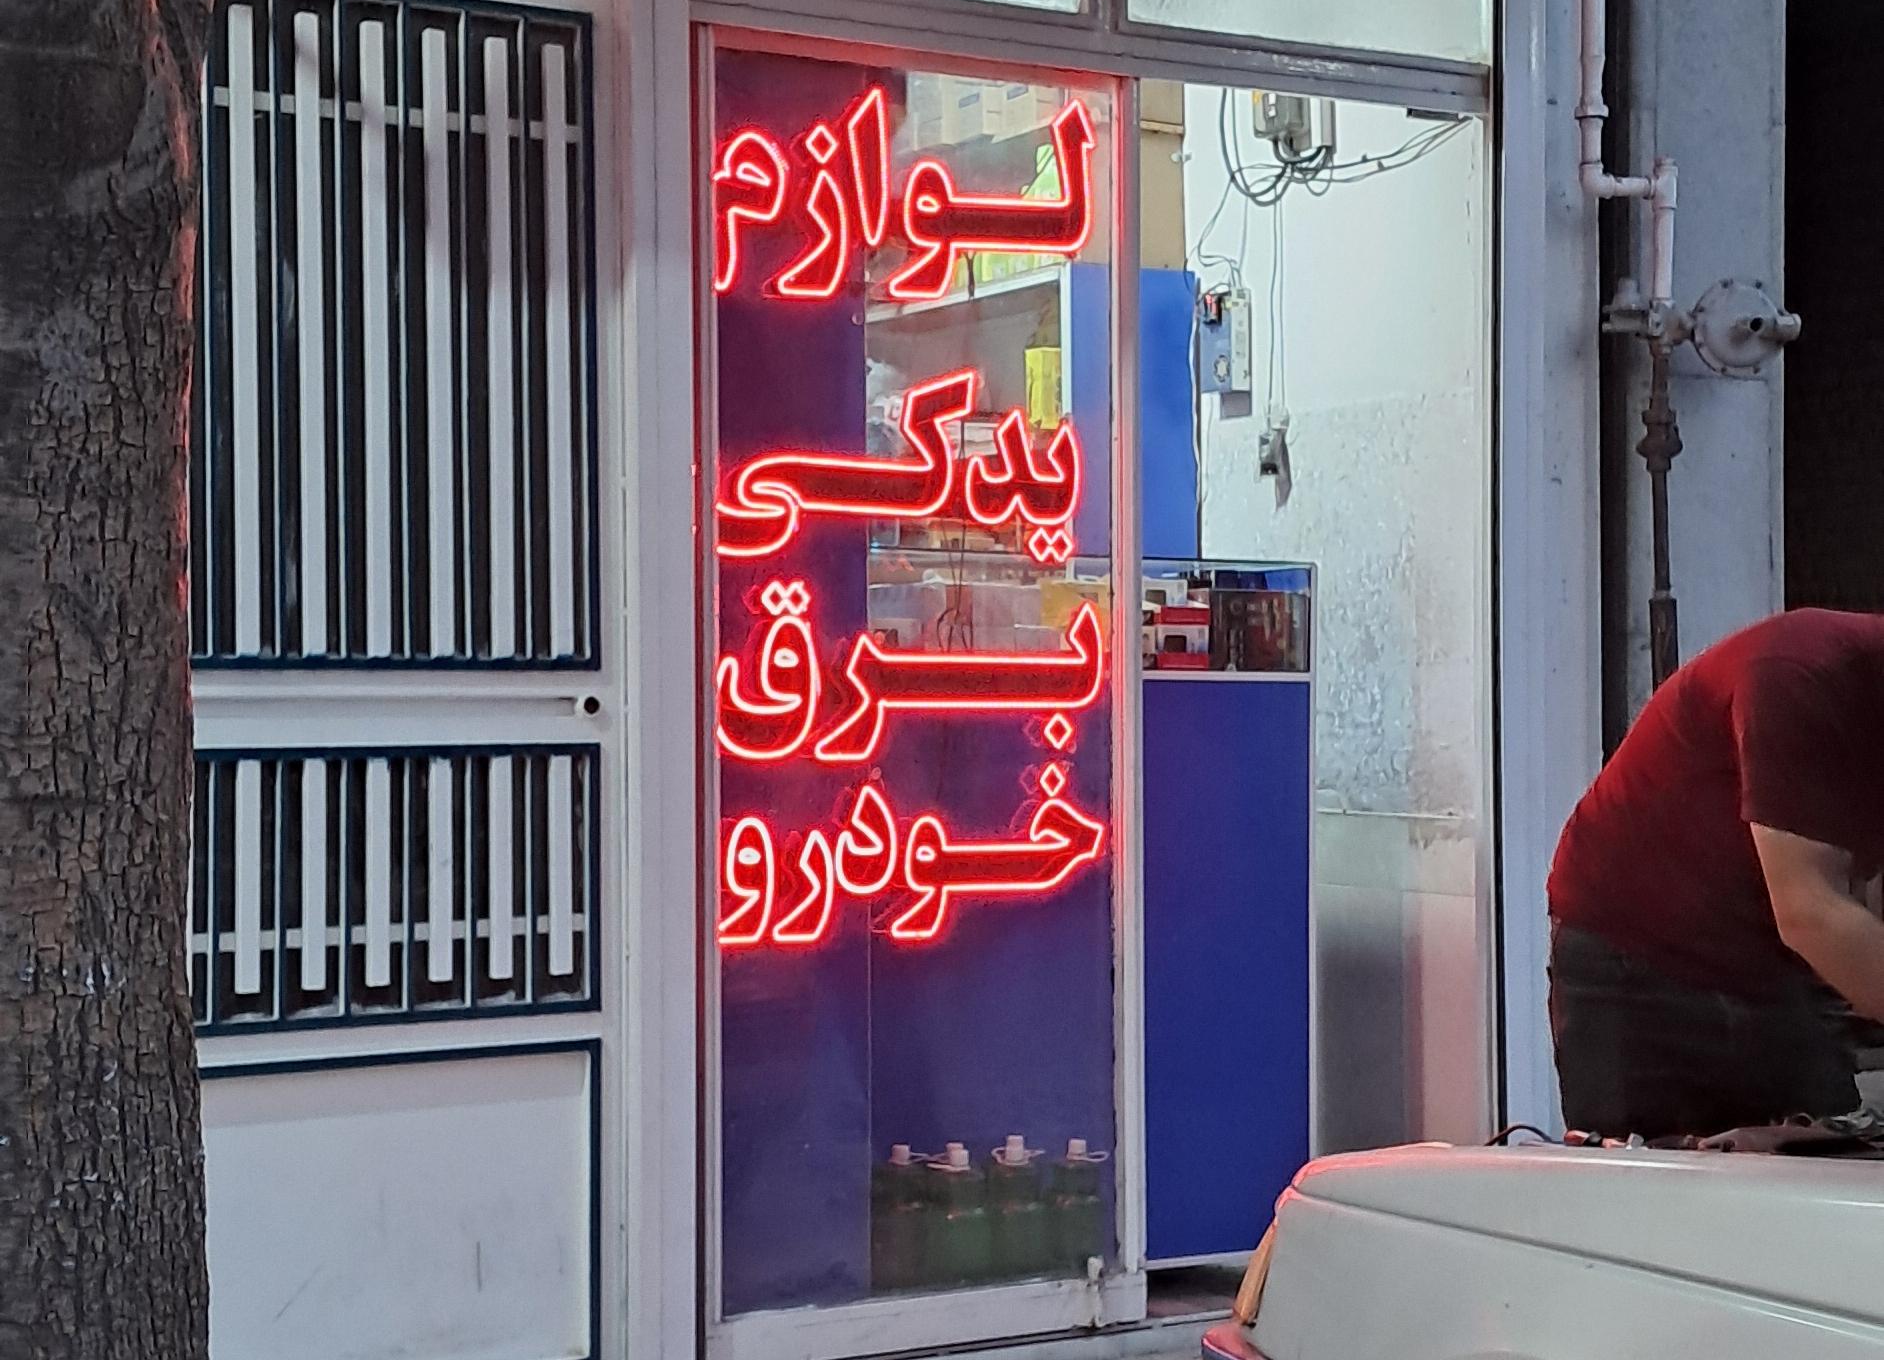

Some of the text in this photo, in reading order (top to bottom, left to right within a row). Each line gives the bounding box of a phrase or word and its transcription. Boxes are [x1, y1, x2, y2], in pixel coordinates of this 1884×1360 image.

[713, 86, 1097, 299] لوازم
[714, 370, 1081, 564] یدکی
[716, 580, 1104, 761] برق
[718, 762, 1105, 945] خودرو
